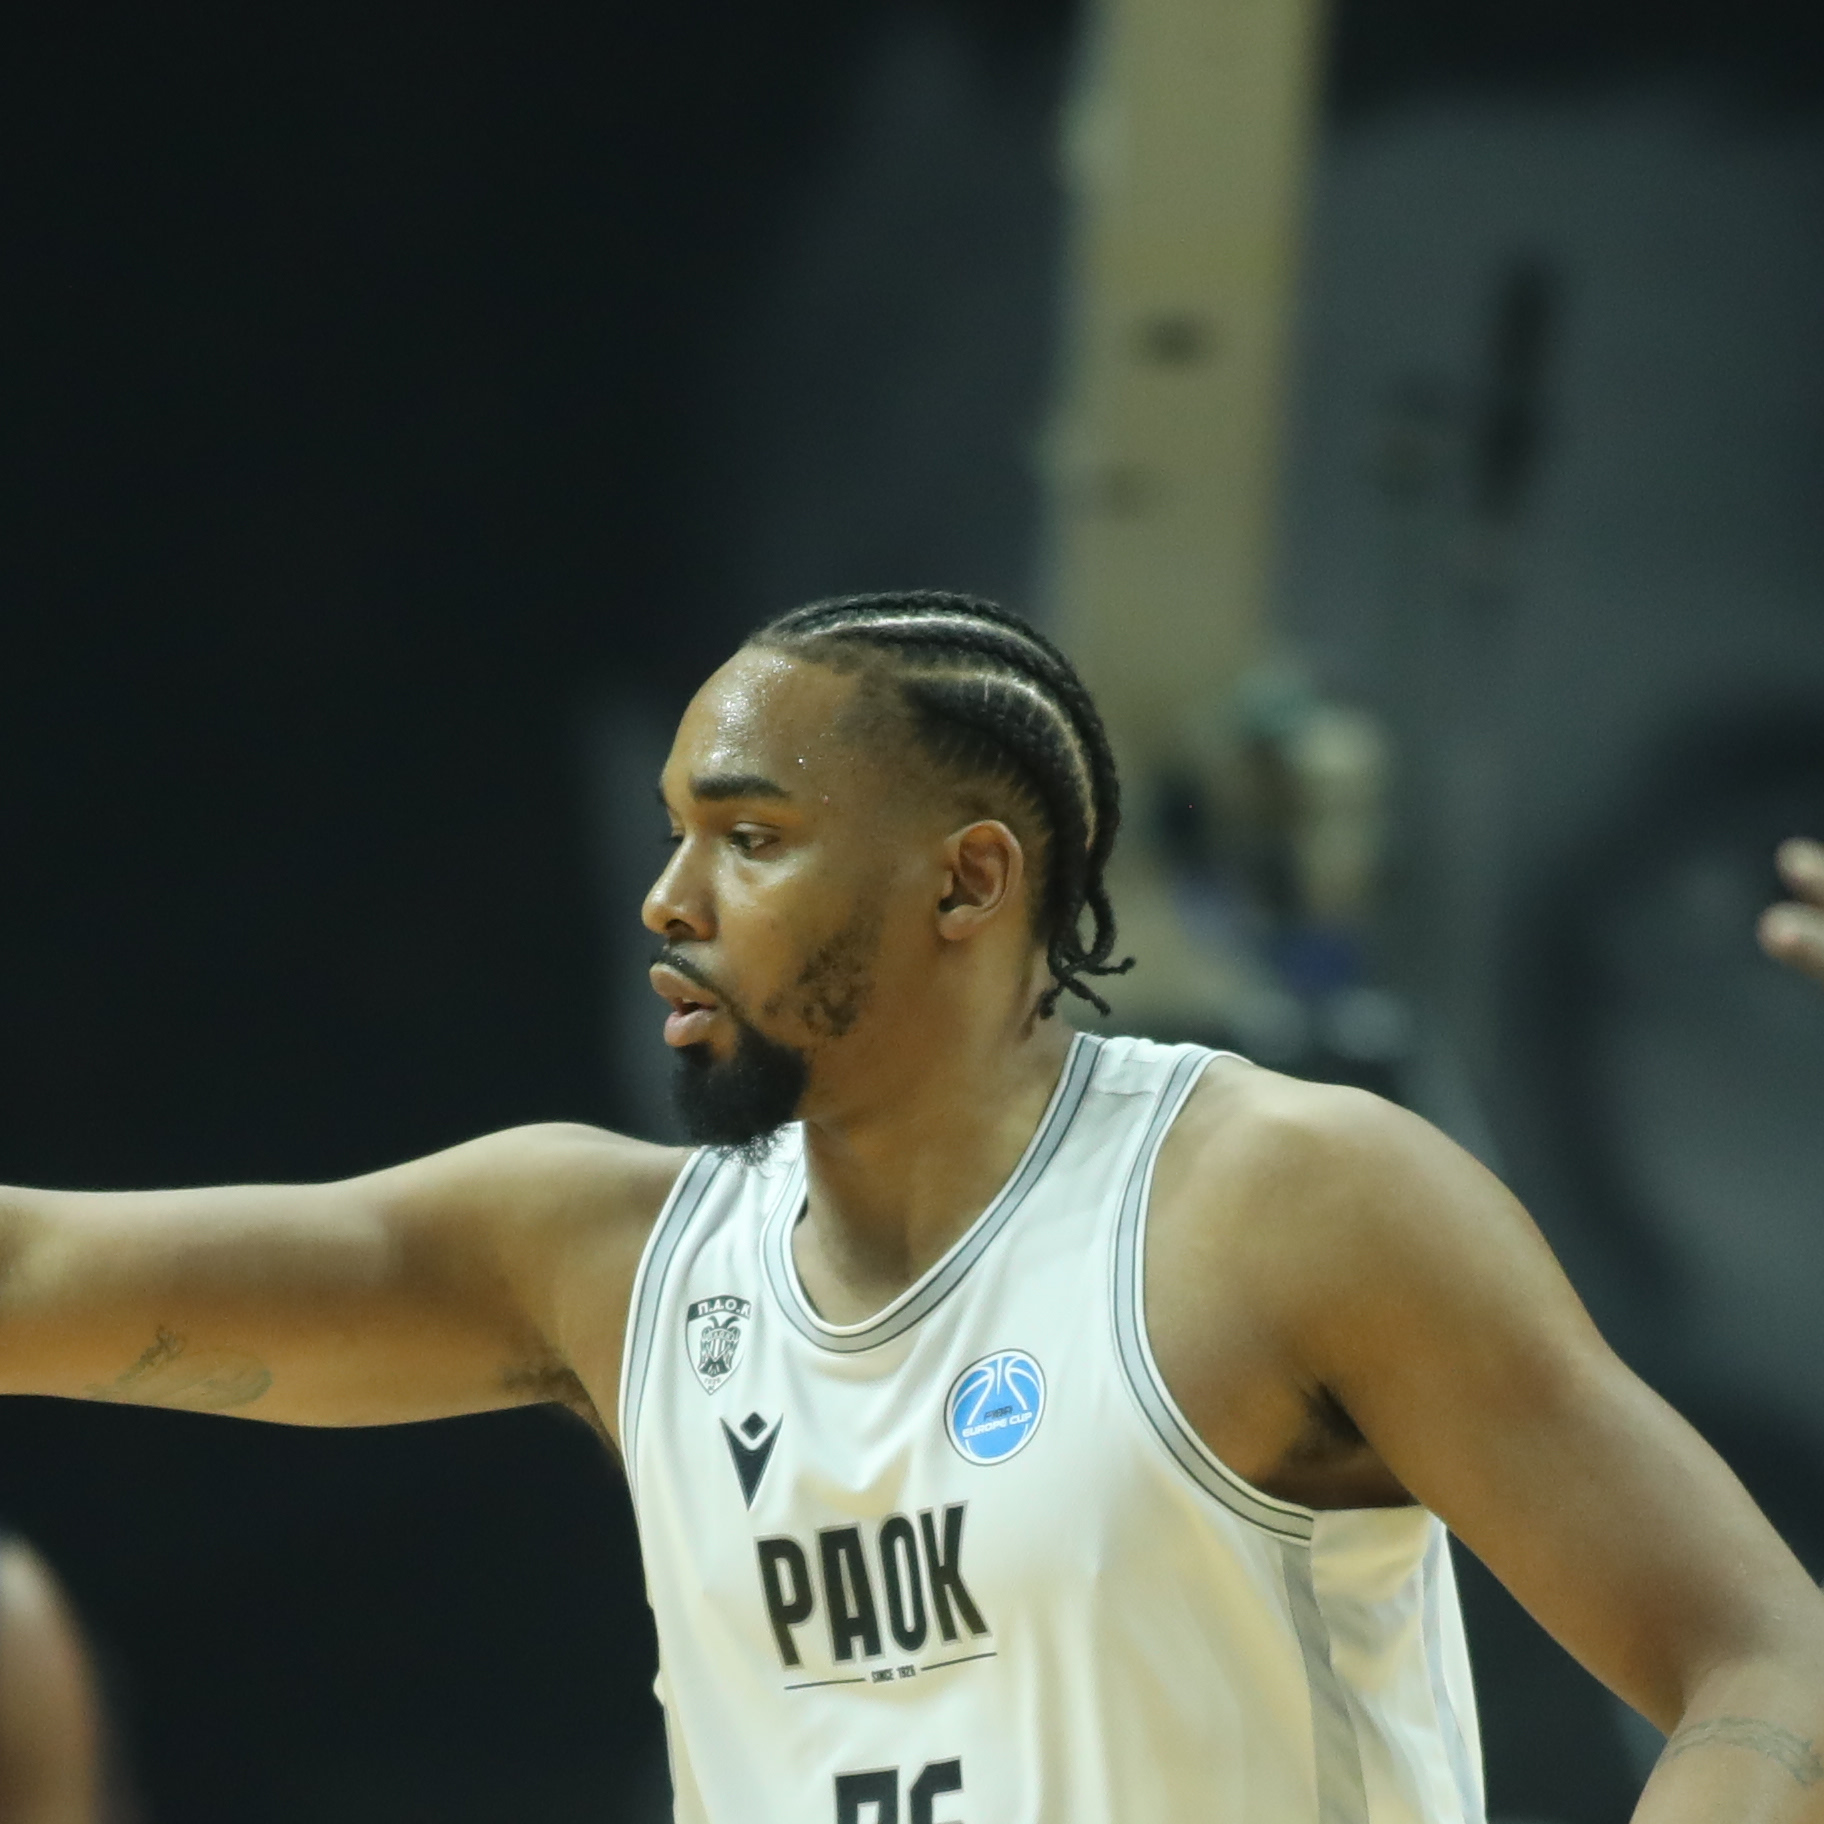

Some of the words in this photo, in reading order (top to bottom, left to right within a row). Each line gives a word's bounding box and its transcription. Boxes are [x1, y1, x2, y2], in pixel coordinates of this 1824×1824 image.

[961, 1417, 1008, 1438] EUROPE
[1009, 1411, 1033, 1426] CUP
[753, 1500, 992, 1670] PAOK
